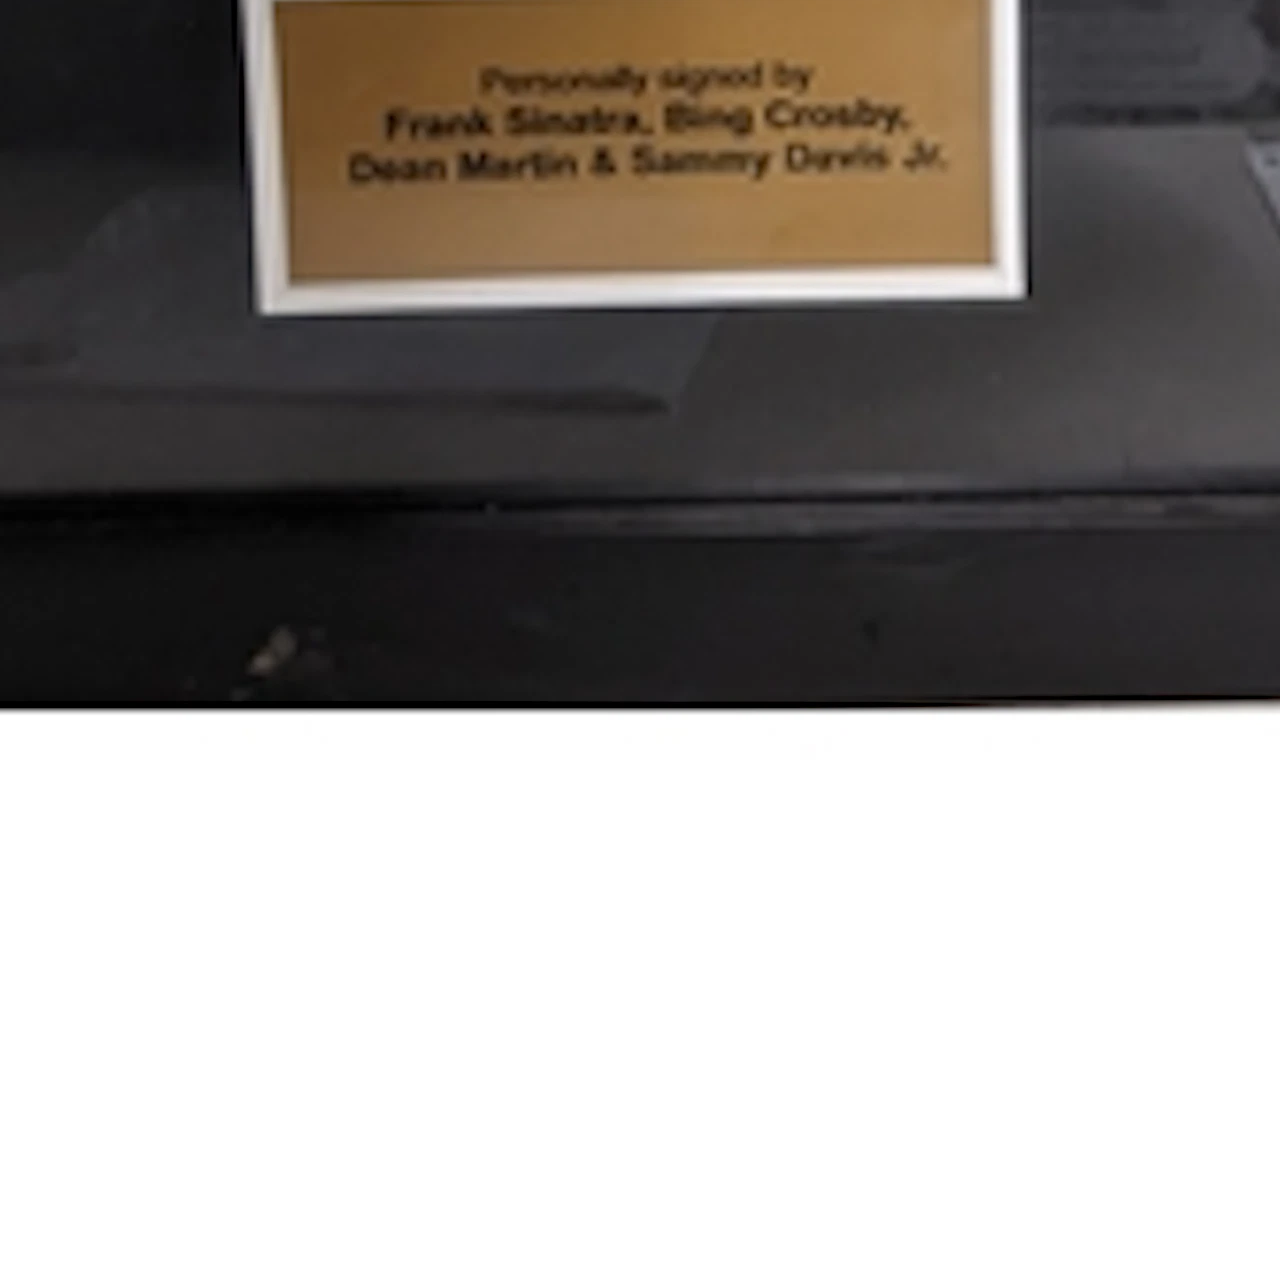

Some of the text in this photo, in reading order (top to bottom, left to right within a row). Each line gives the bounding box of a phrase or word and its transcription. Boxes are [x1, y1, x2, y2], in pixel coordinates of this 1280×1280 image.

[478, 58, 816, 98] Personally signed by
[383, 96, 913, 142] Frank Sinatra, Bing Crosby,
[348, 138, 949, 184] Dean Martin & Sammy Davis Jr.
